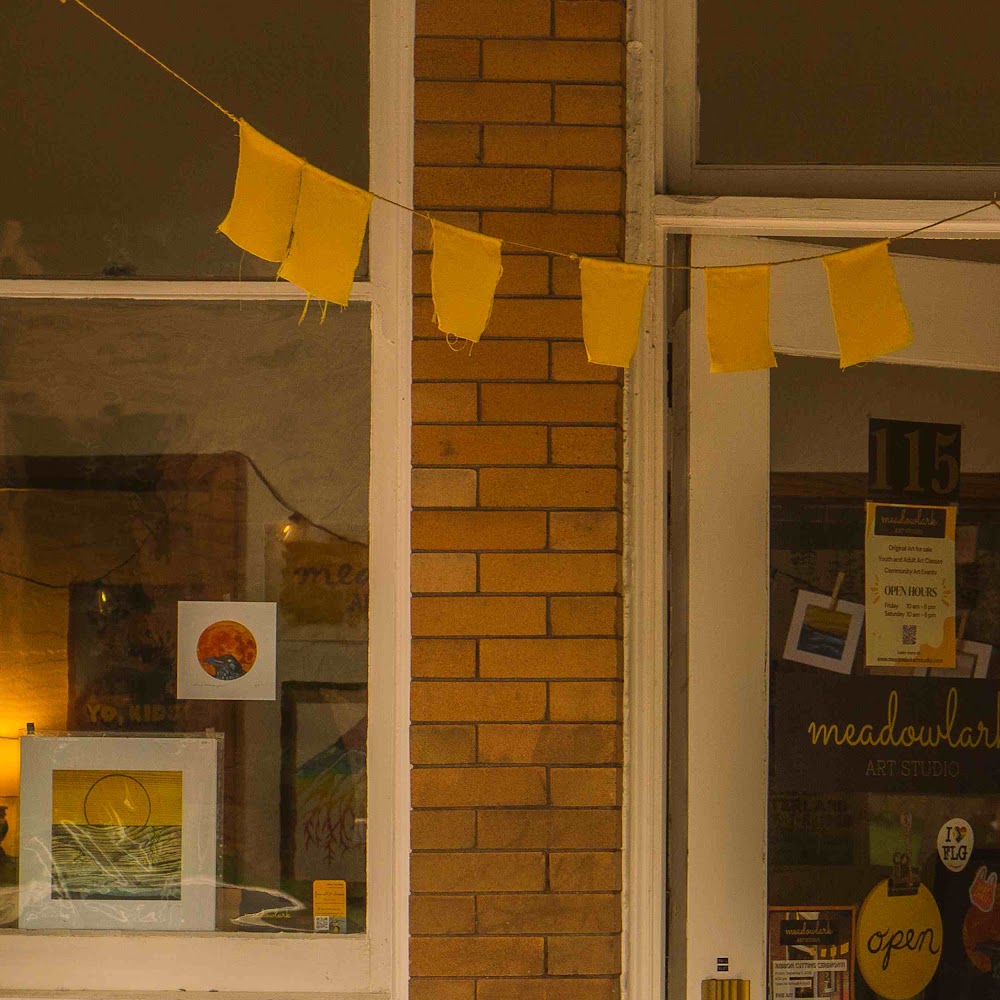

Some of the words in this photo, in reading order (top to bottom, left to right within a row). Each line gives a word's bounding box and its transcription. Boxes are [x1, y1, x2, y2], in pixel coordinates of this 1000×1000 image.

[869, 427, 957, 494] 115
[888, 544, 906, 552] Original
[884, 567, 912, 575] Community
[884, 585, 907, 595] OPEN
[908, 586, 938, 597] HOURS
[865, 759, 895, 776] ART
[901, 760, 960, 778] STUDIO
[946, 826, 953, 842] I
[942, 845, 968, 860] FLG
[867, 928, 940, 970] open
